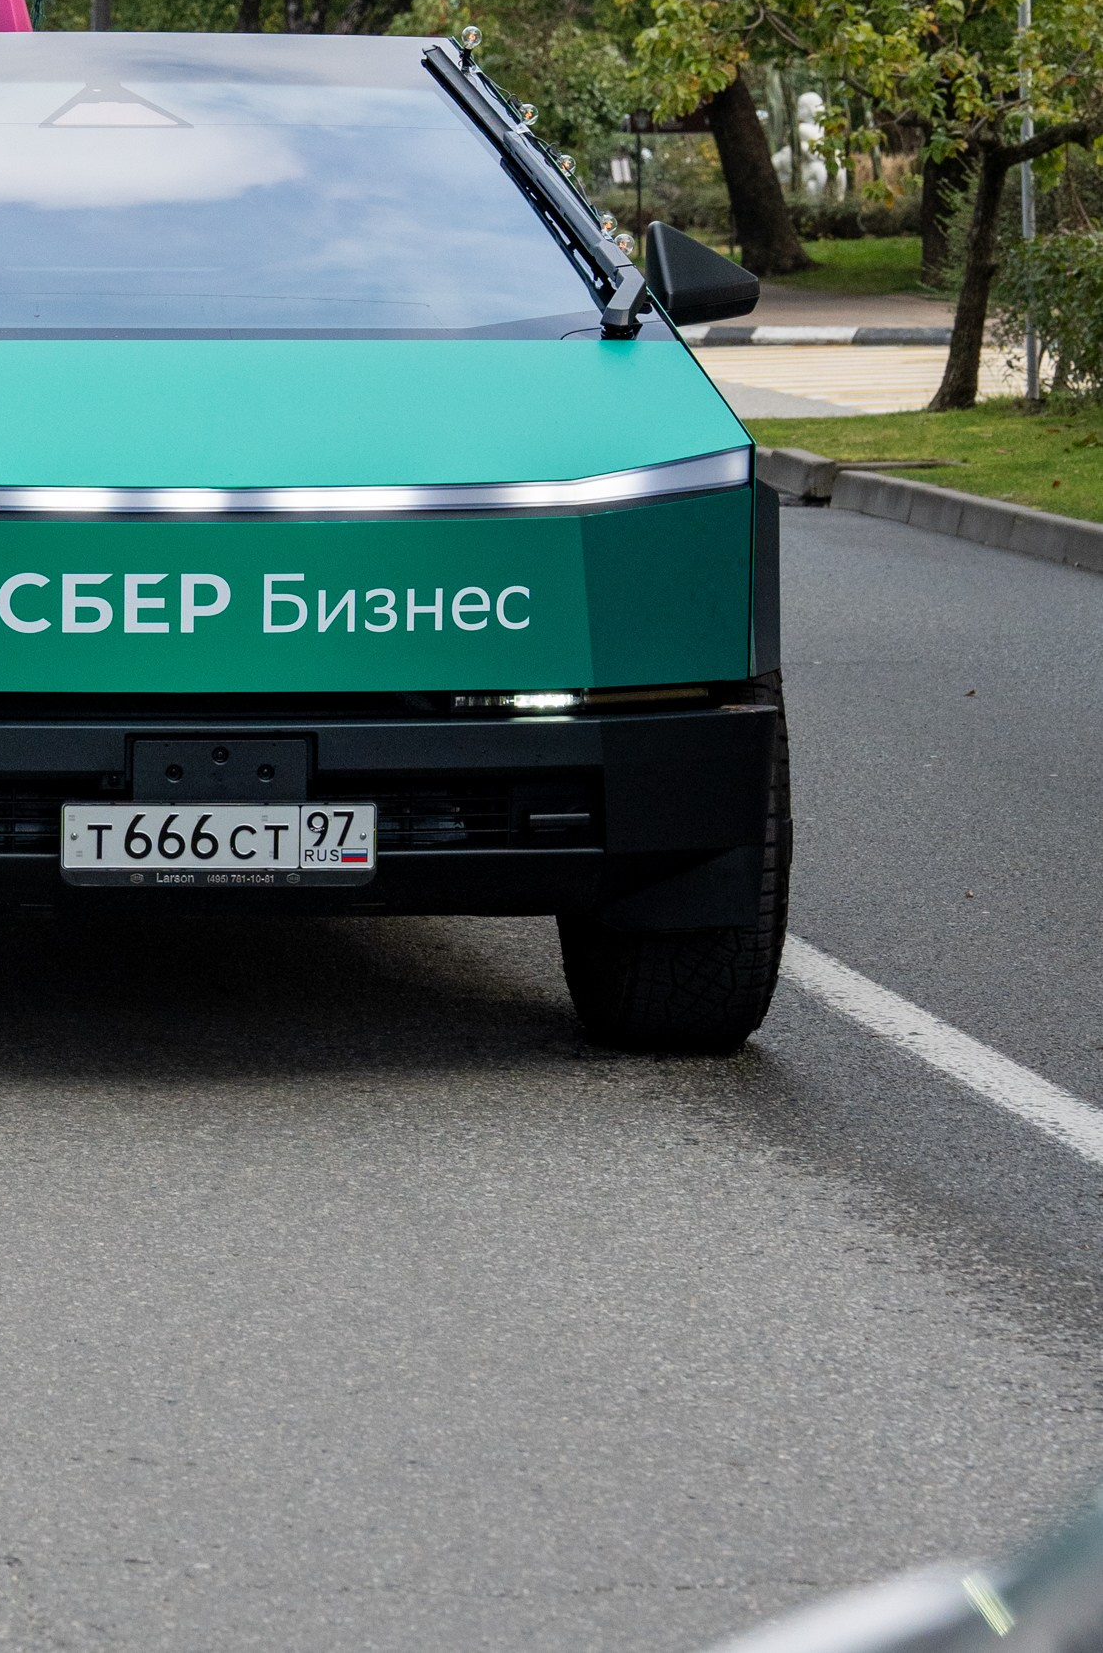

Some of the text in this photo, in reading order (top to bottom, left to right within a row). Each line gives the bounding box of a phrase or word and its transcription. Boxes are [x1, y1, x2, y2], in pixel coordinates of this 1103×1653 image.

[262, 572, 531, 633] Бизнес
[306, 811, 355, 847] 97
[304, 849, 340, 863] RUS
[156, 872, 195, 884] Larson
